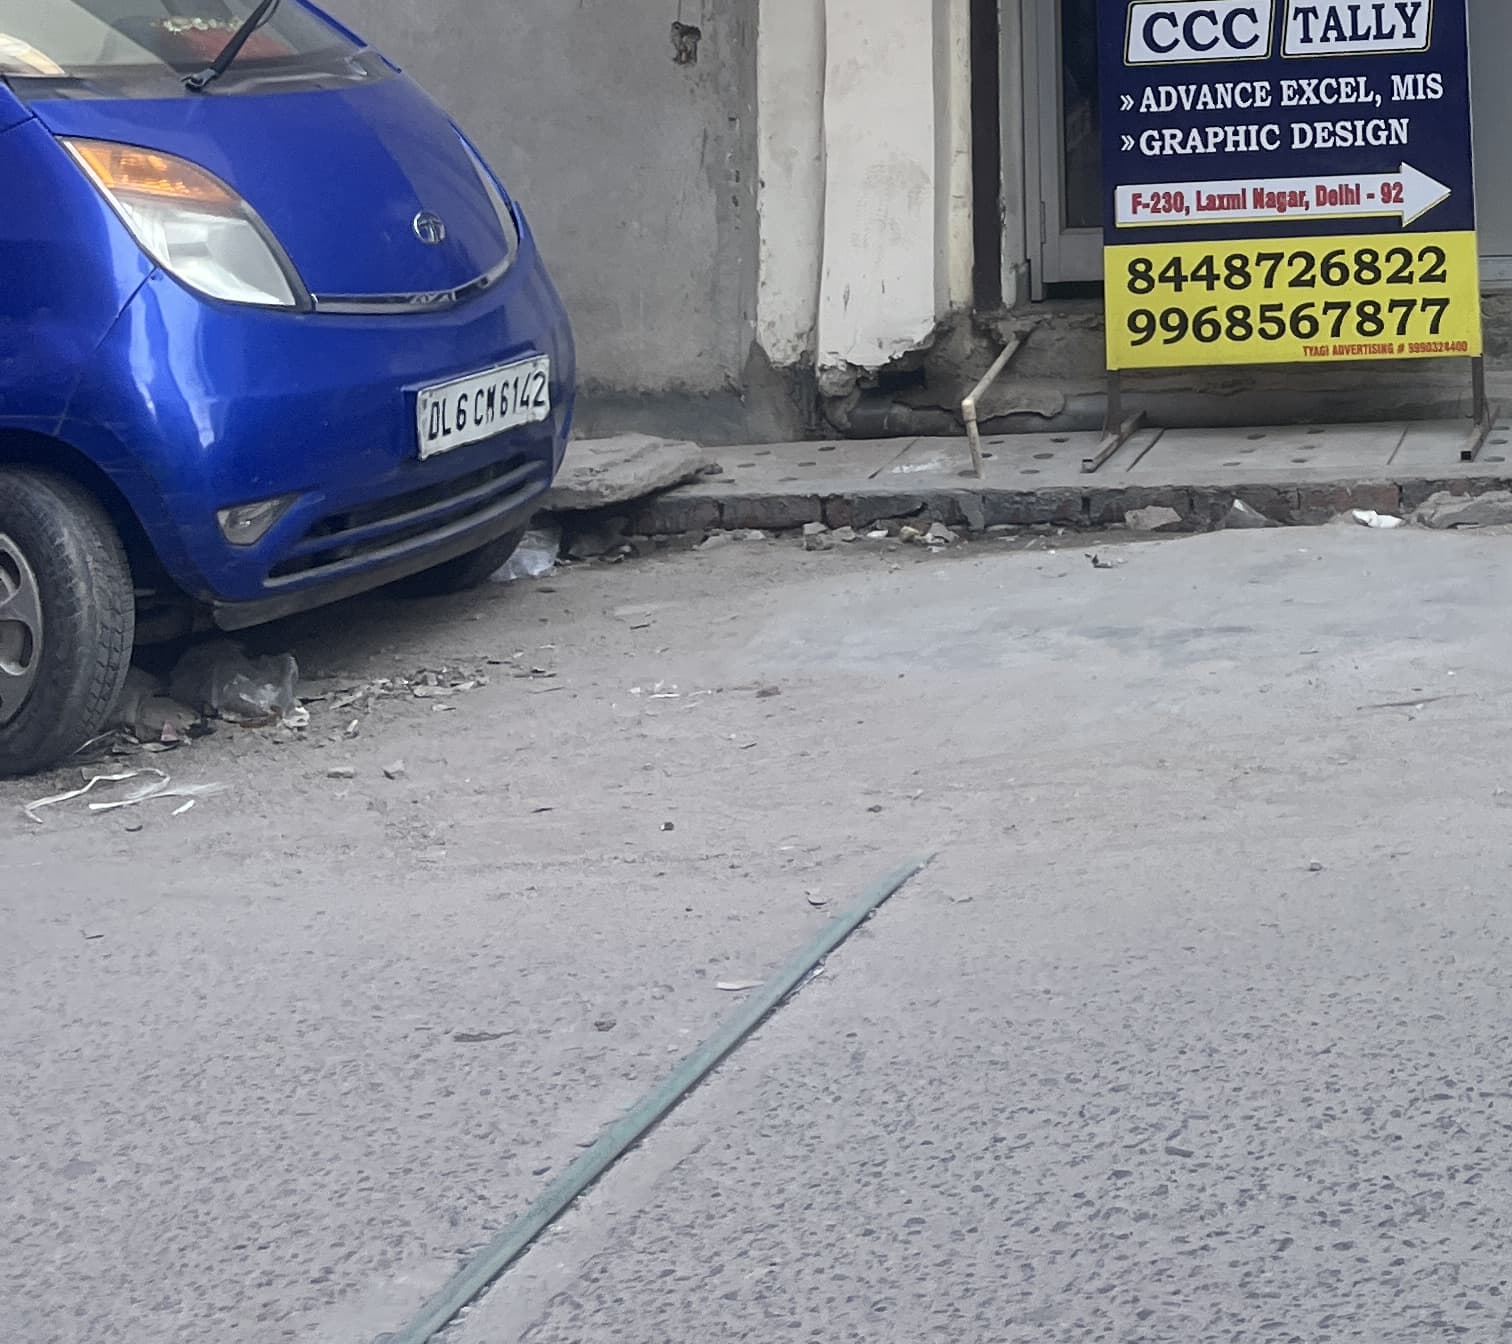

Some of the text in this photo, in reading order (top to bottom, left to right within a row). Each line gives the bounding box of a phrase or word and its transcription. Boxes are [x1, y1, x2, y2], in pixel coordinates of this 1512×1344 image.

[1142, 7, 1261, 53] CCC
[1292, 1, 1423, 45] TALLY
[1139, 72, 1445, 114] ADVANCE EXCEL, MIS
[1139, 118, 1410, 156] GRAPHIC DESIGN
[1131, 190, 1191, 215] F-230,
[1196, 187, 1248, 213] Laxmi
[1253, 185, 1310, 213] Nagar,
[1315, 182, 1362, 208] Delhi
[1379, 180, 1405, 204] 92
[1126, 245, 1449, 295] 8448726822
[1127, 296, 1452, 347] 9968567877
